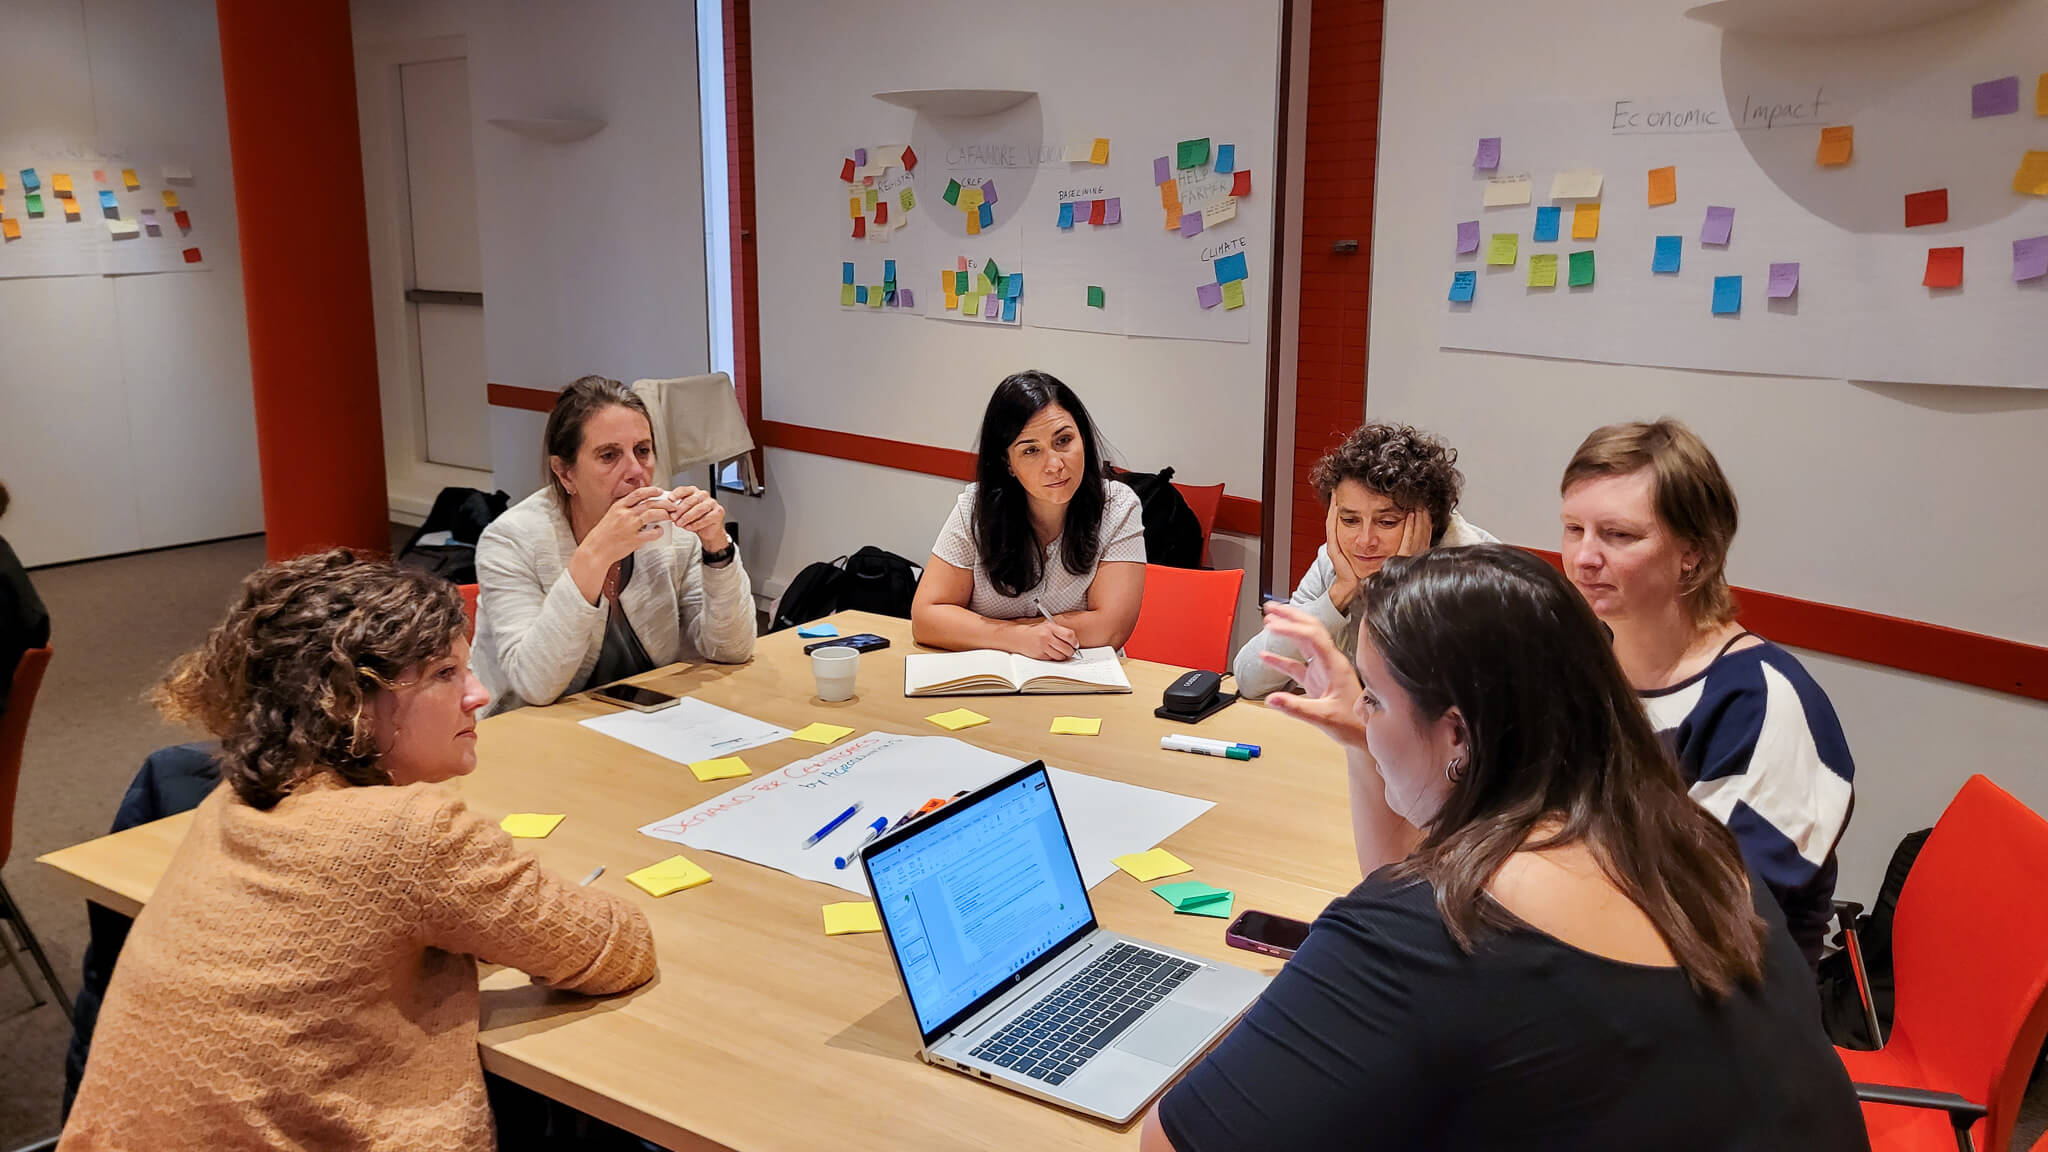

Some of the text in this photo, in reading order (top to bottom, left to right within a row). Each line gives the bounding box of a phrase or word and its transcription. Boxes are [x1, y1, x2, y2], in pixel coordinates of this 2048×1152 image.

[1612, 87, 1832, 130] Economic Impact
[1178, 168, 1209, 185] HELP
[1058, 185, 1104, 200] BASELINING
[1200, 236, 1247, 262] CLIMATE
